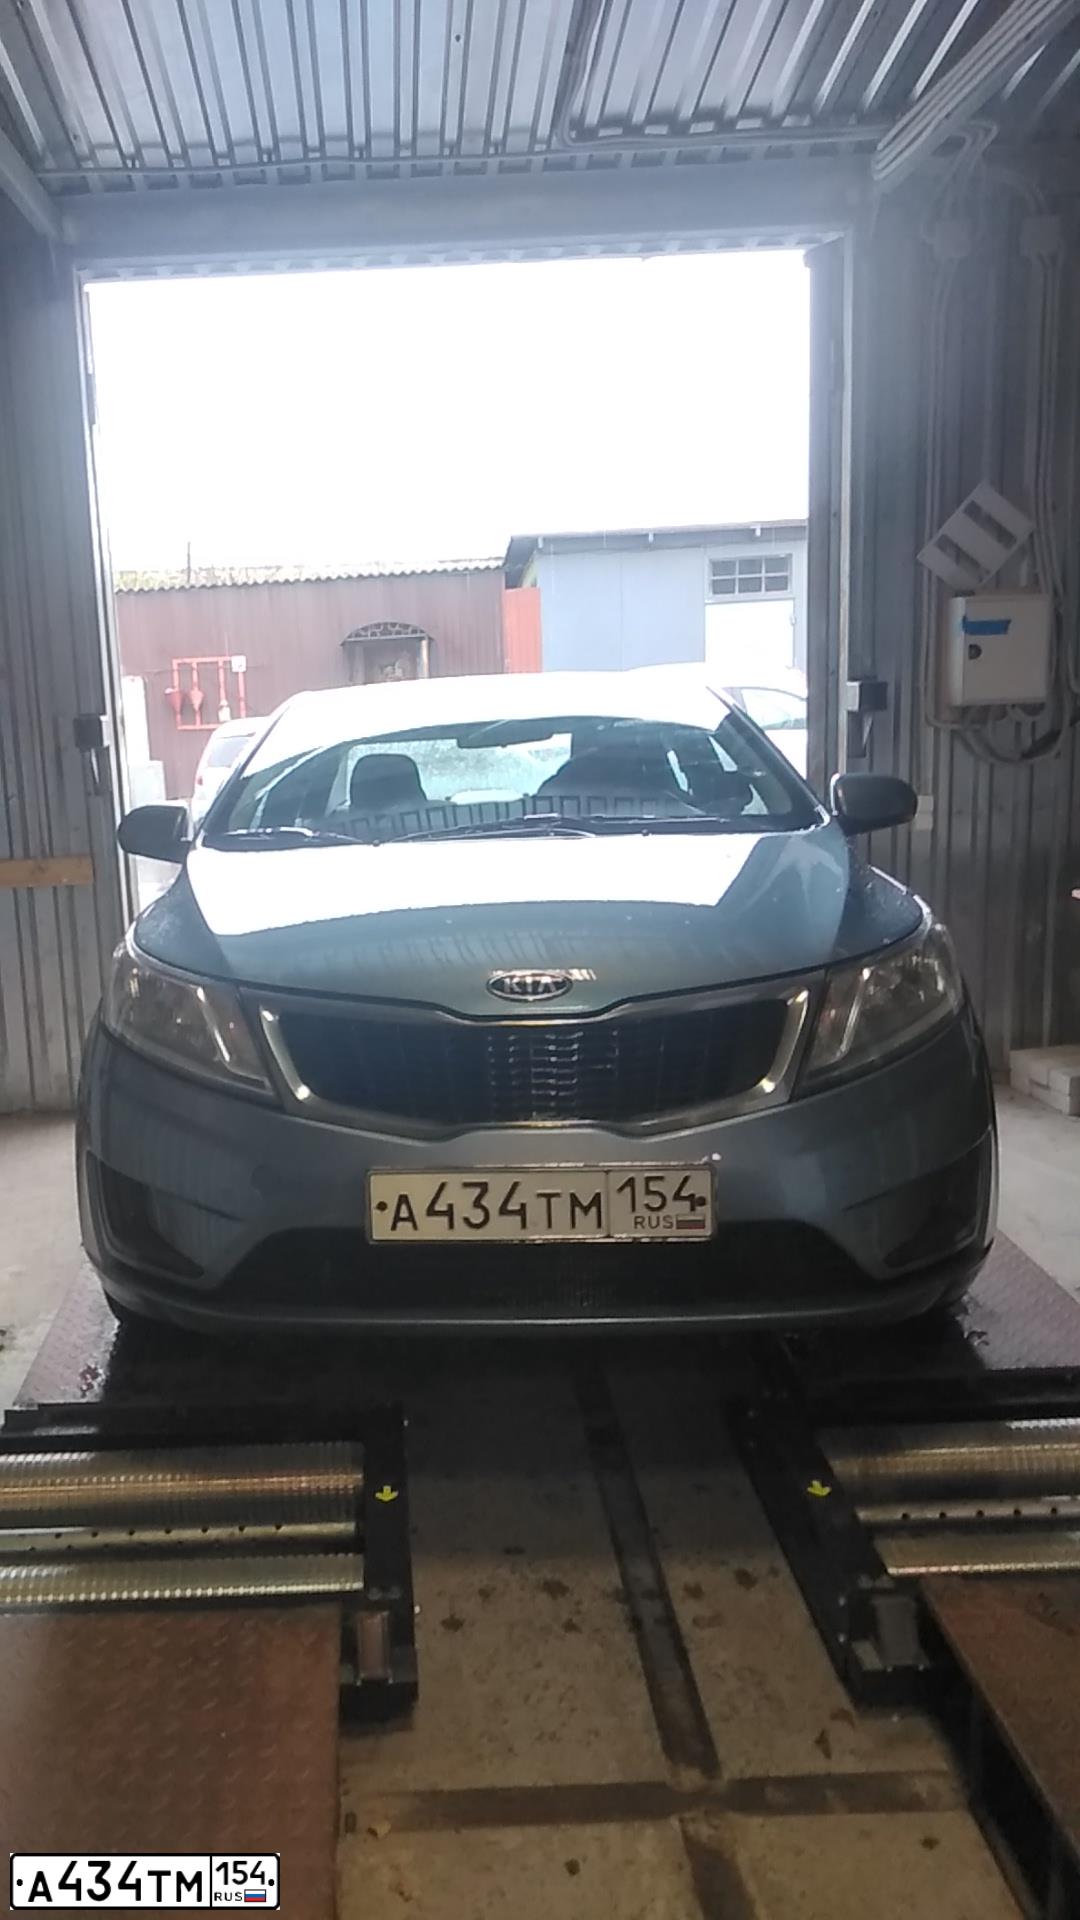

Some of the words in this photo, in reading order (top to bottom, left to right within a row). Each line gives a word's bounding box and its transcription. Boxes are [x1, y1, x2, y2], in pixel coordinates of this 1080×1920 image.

[503, 977, 557, 993] KIA
[616, 1176, 697, 1212] 154
[633, 1216, 674, 1230] RUS
